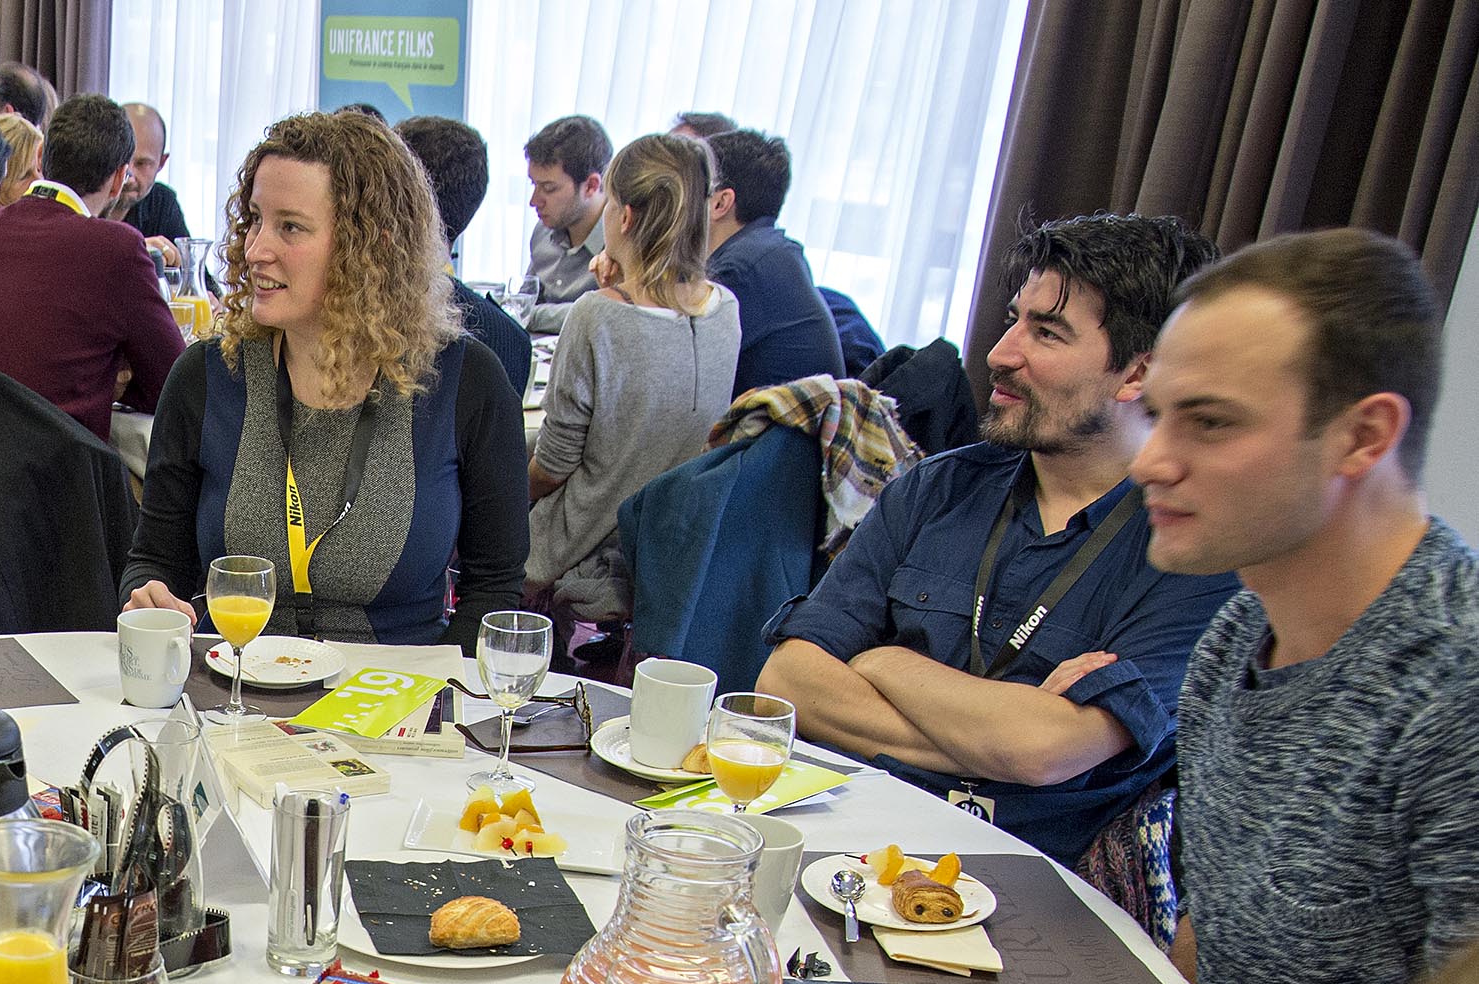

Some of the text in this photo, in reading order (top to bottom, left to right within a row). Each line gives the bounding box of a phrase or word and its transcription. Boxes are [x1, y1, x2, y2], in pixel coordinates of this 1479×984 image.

[329, 28, 434, 58] UNIFRANCE FILMS
[289, 485, 302, 527] Nikon
[1009, 605, 1048, 651] Nikon
